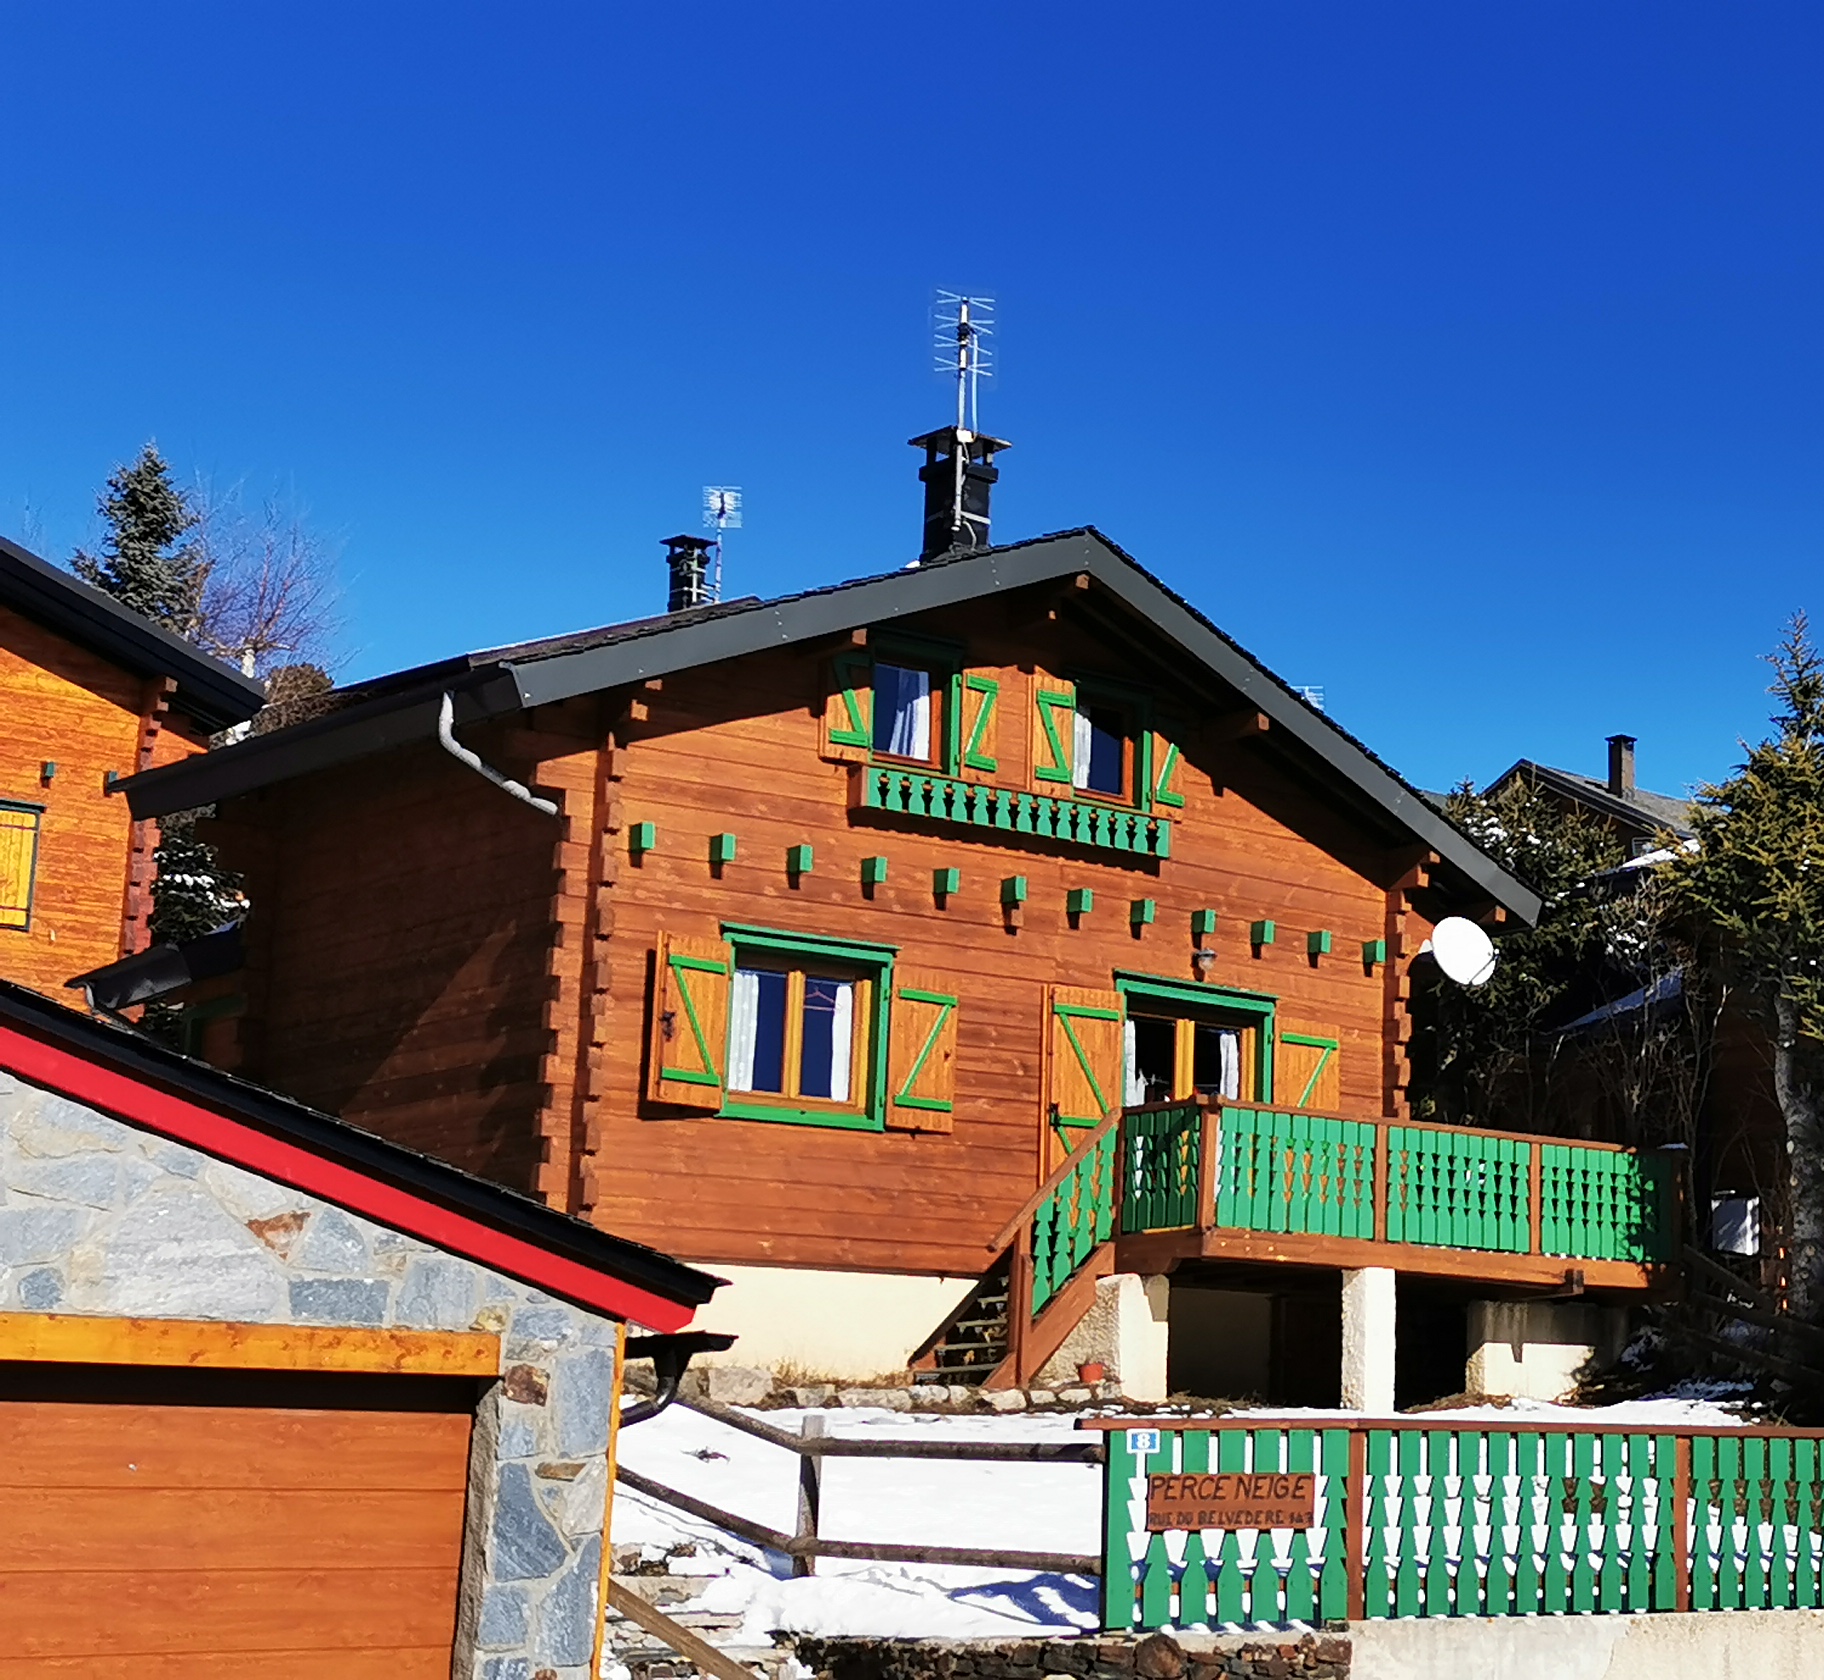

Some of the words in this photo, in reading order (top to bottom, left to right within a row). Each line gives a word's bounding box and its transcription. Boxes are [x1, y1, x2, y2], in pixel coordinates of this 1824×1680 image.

[1136, 1433, 1151, 1449] 8
[1150, 1475, 1231, 1500] PERCE
[1234, 1475, 1312, 1499] NEIGE
[1149, 1511, 1173, 1526] RUE
[1176, 1511, 1193, 1526] DU
[1198, 1509, 1284, 1525] BELVEDERE
